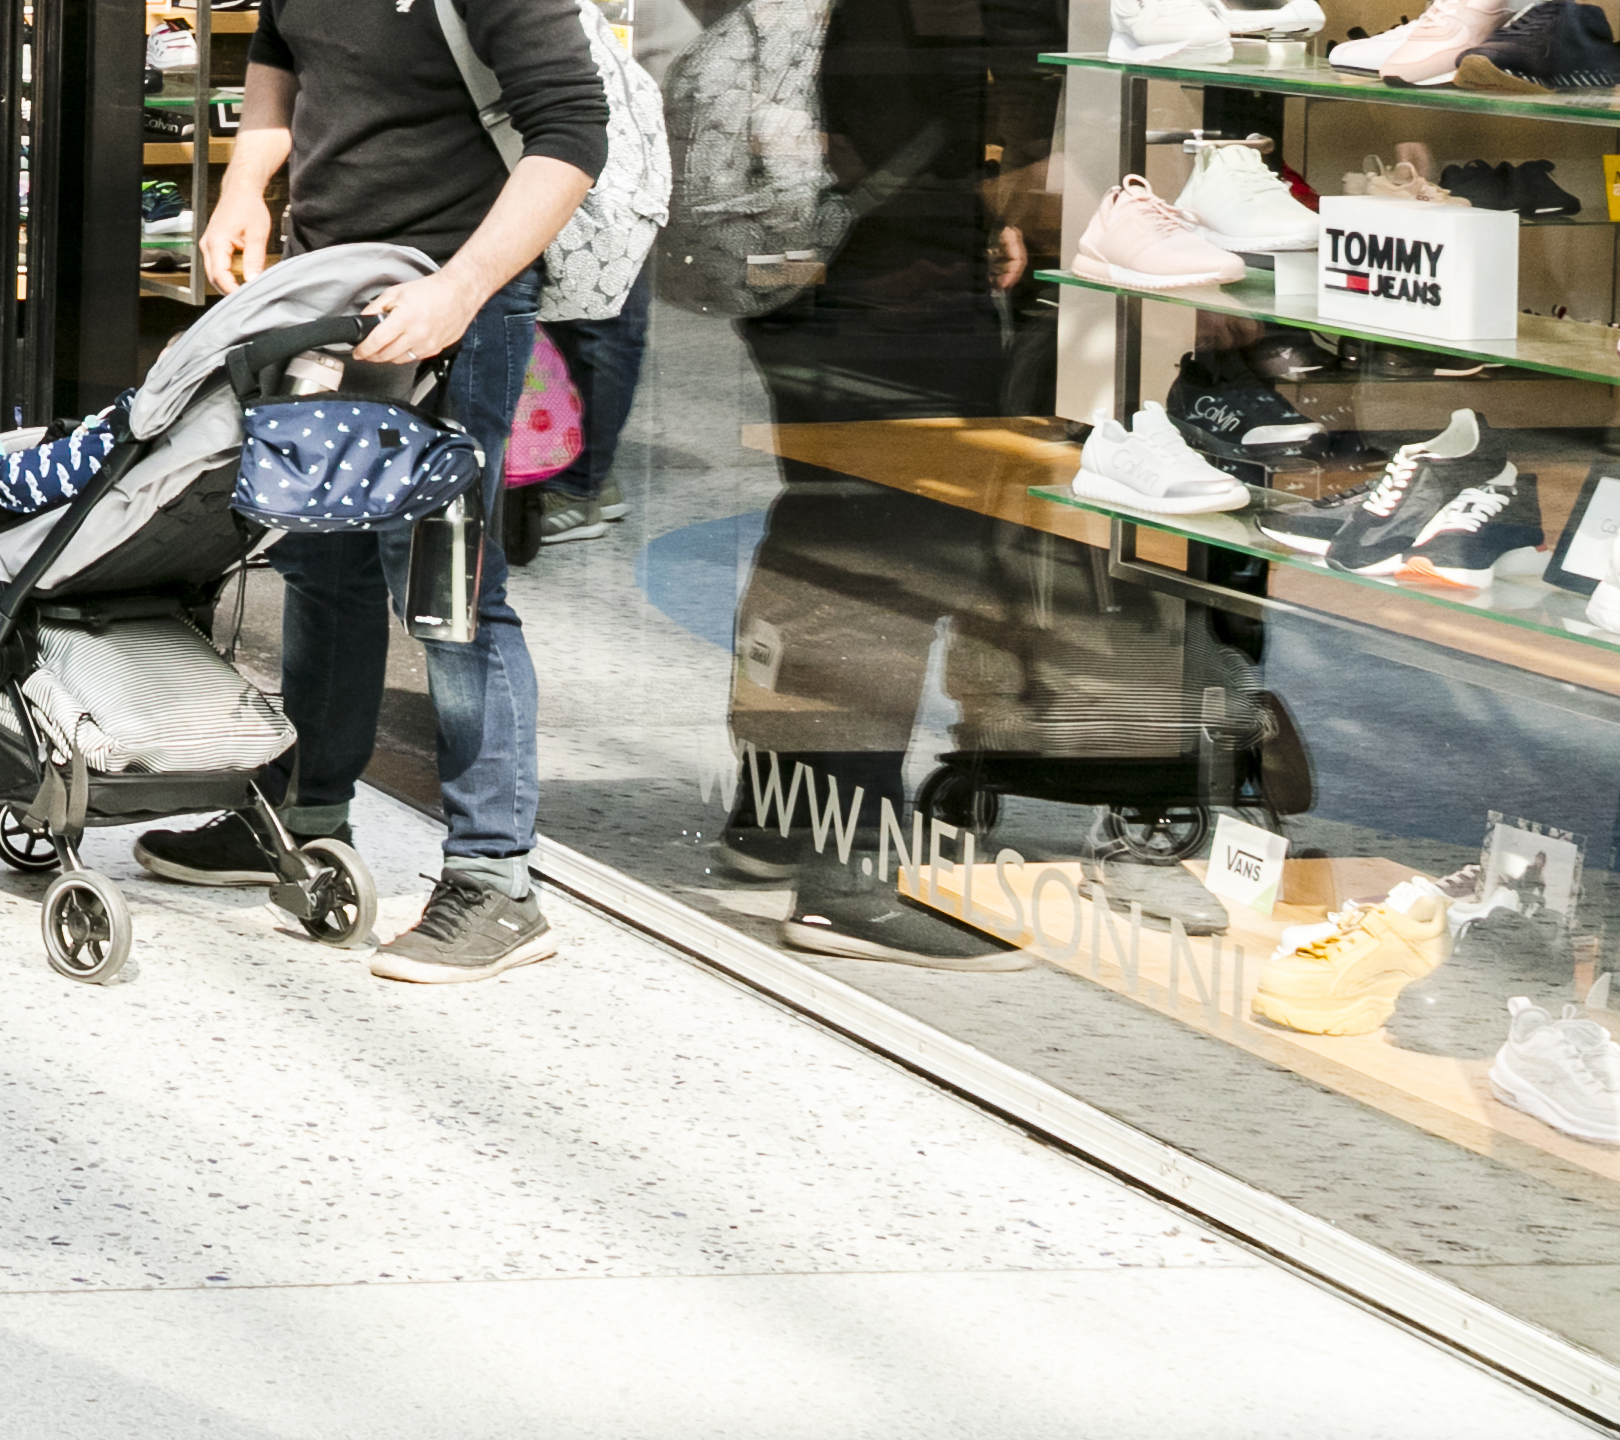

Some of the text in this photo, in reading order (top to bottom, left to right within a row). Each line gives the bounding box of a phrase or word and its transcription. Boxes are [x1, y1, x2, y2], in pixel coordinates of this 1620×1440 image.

[1325, 227, 1445, 279] TOMMY
[1370, 274, 1443, 308] JEANS
[1194, 395, 1242, 433] Calvin
[1226, 844, 1264, 884] VANS
